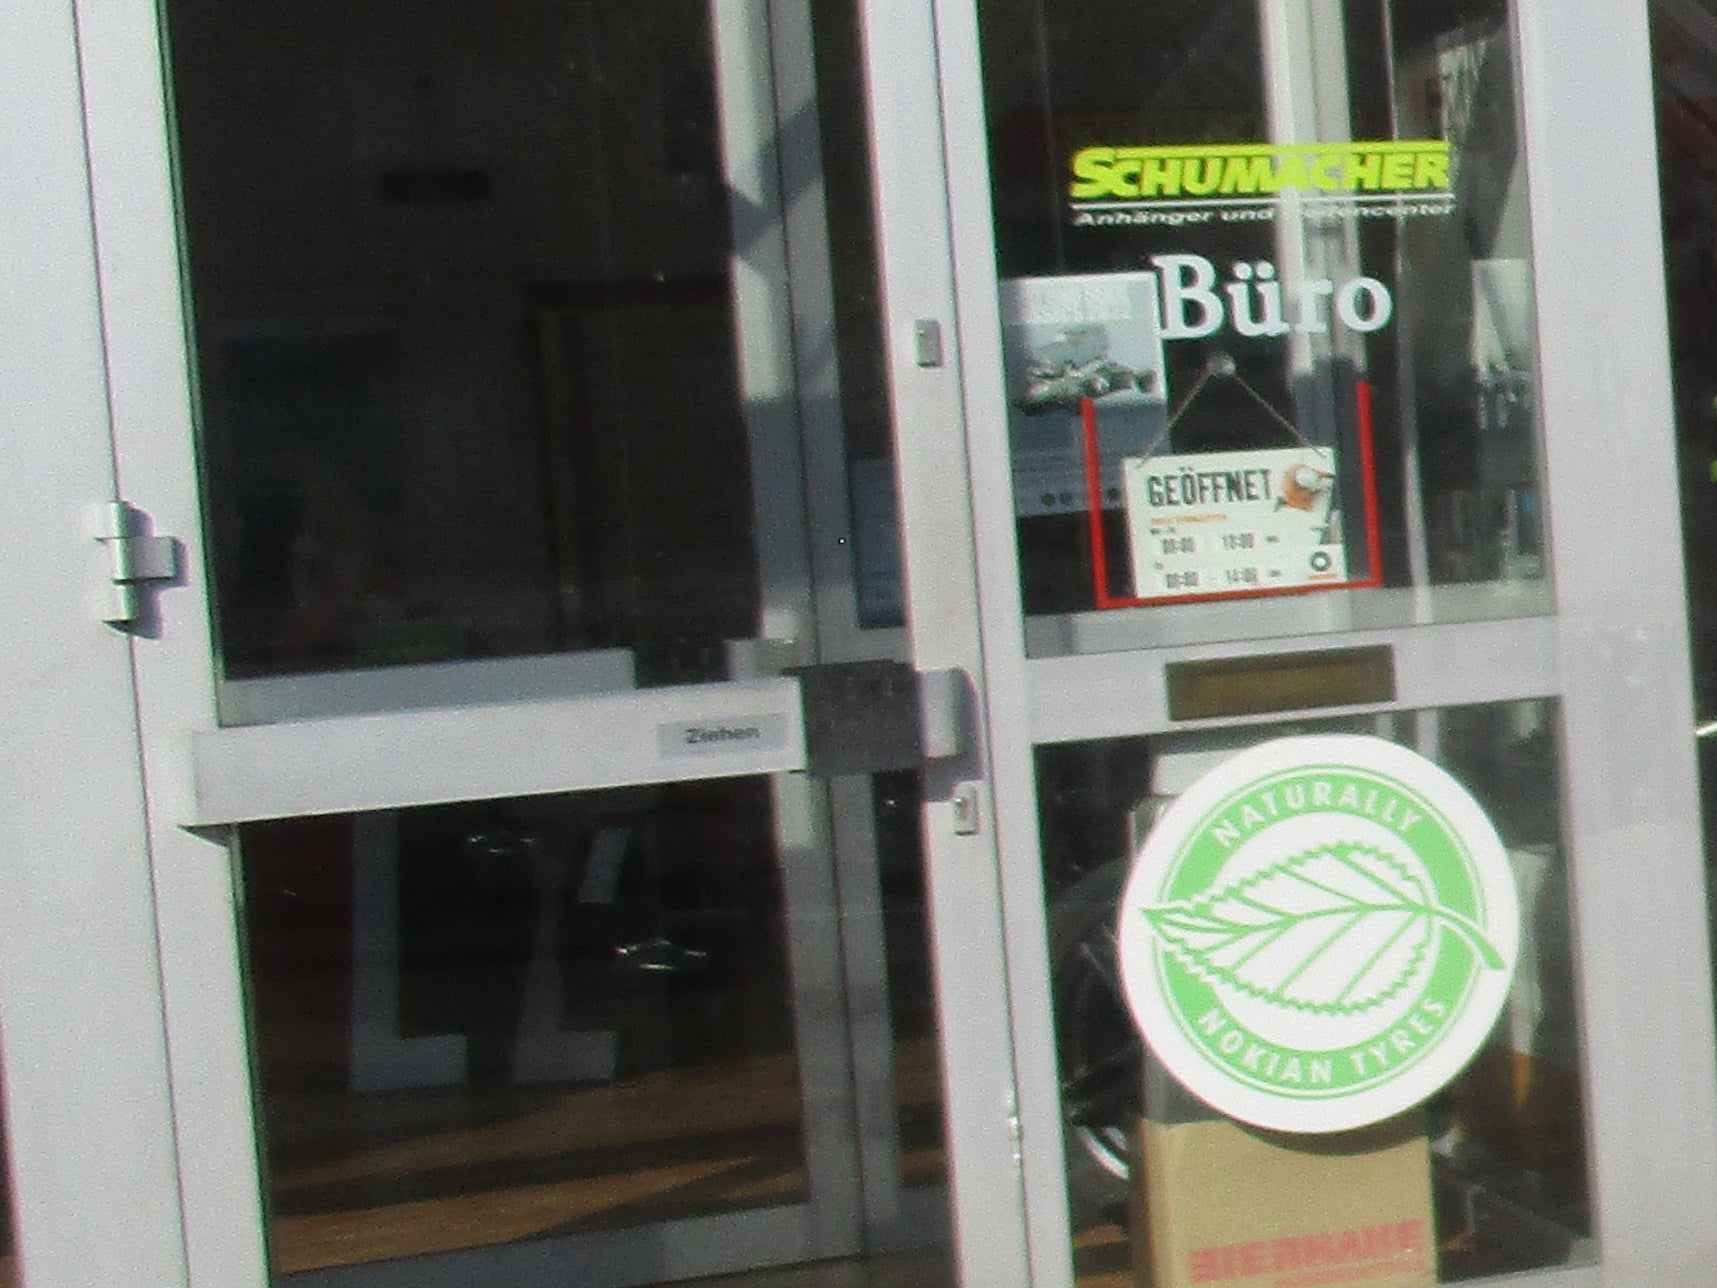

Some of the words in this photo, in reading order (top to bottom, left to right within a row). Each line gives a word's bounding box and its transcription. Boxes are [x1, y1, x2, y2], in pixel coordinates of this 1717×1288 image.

[1070, 141, 1451, 199] SCHUMACHER
[1073, 210, 1214, 227] Anhänger
[1151, 253, 1394, 341] Büro
[1147, 467, 1273, 506] GEÖFFNET
[1213, 780, 1424, 847] NATURALLY
[1197, 1005, 1332, 1084] NOKIAN
[1350, 997, 1447, 1077] TYRES
